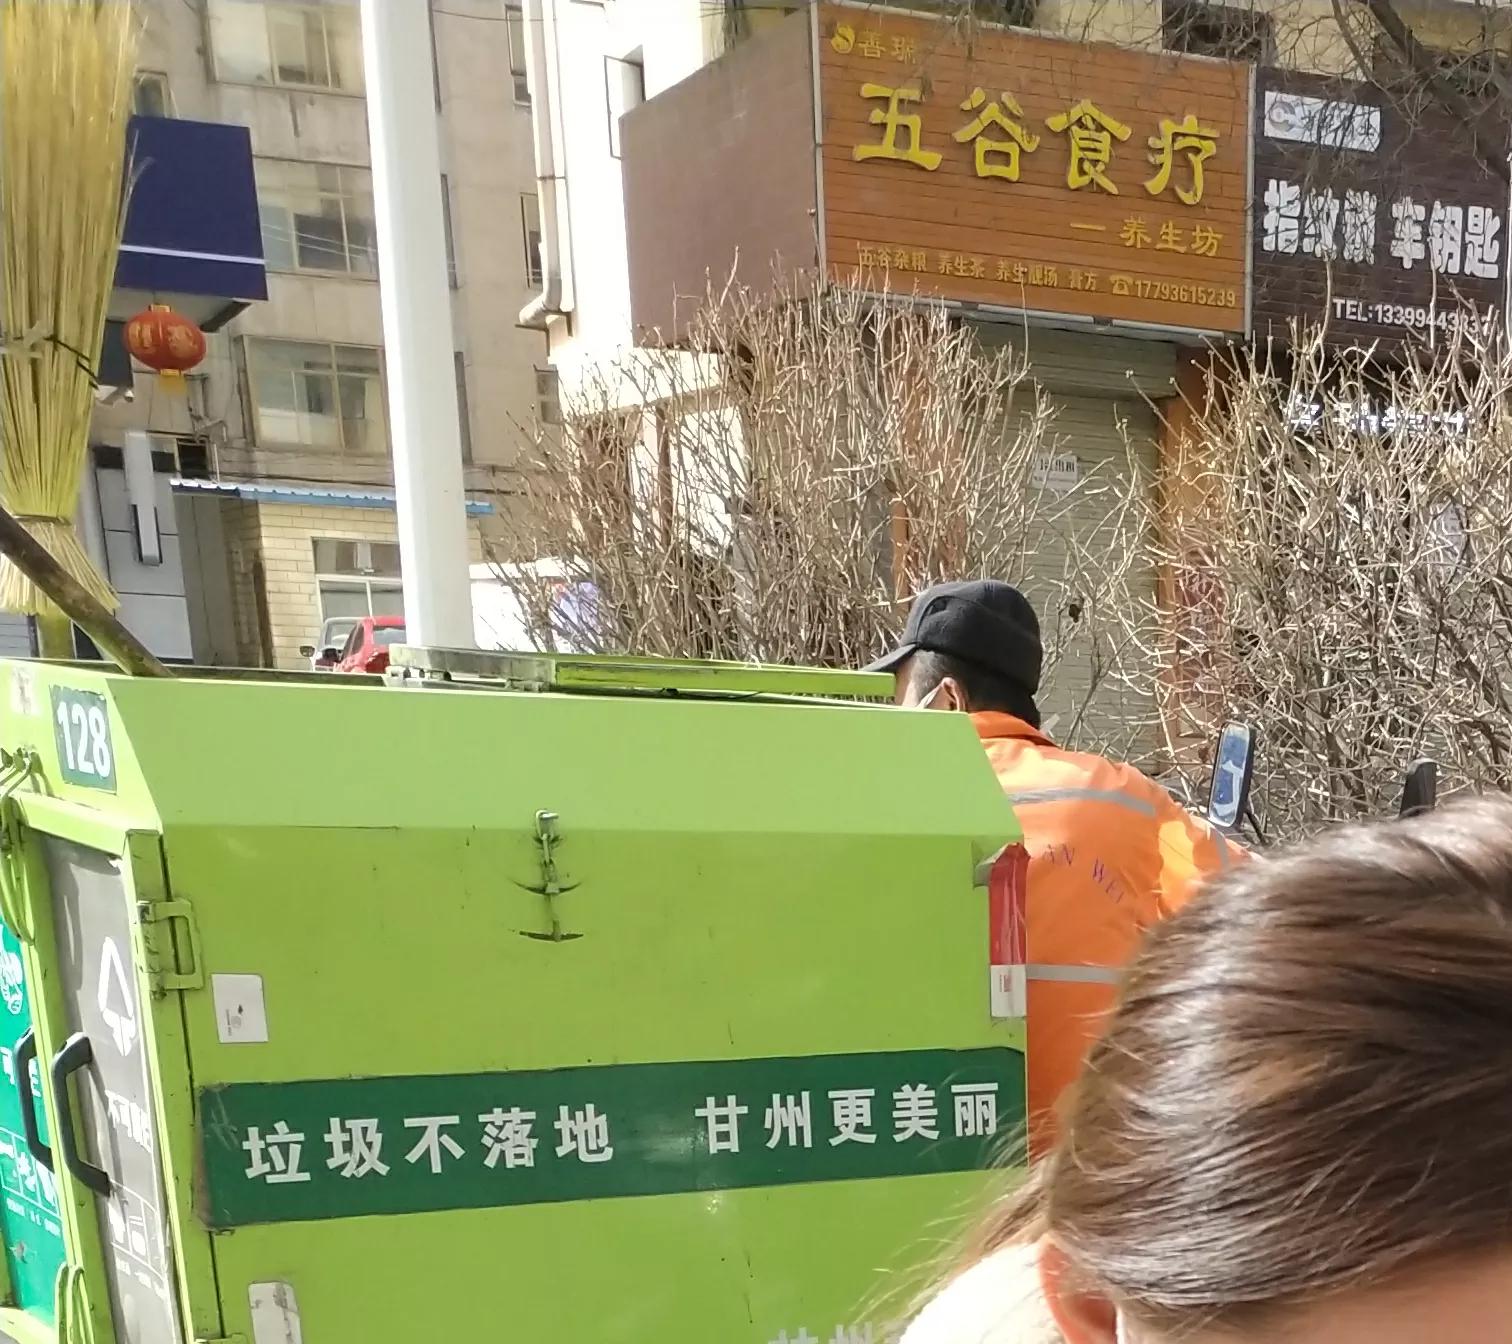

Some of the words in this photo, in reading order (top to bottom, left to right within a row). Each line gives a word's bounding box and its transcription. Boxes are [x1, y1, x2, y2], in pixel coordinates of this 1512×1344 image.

[852, 82, 1220, 205] 五谷食疗
[1135, 280, 1236, 307] 17793615239
[57, 701, 110, 778] 128
[242, 1103, 614, 1184] 垃圾不落地
[694, 1082, 999, 1154] 甘州更美丽
